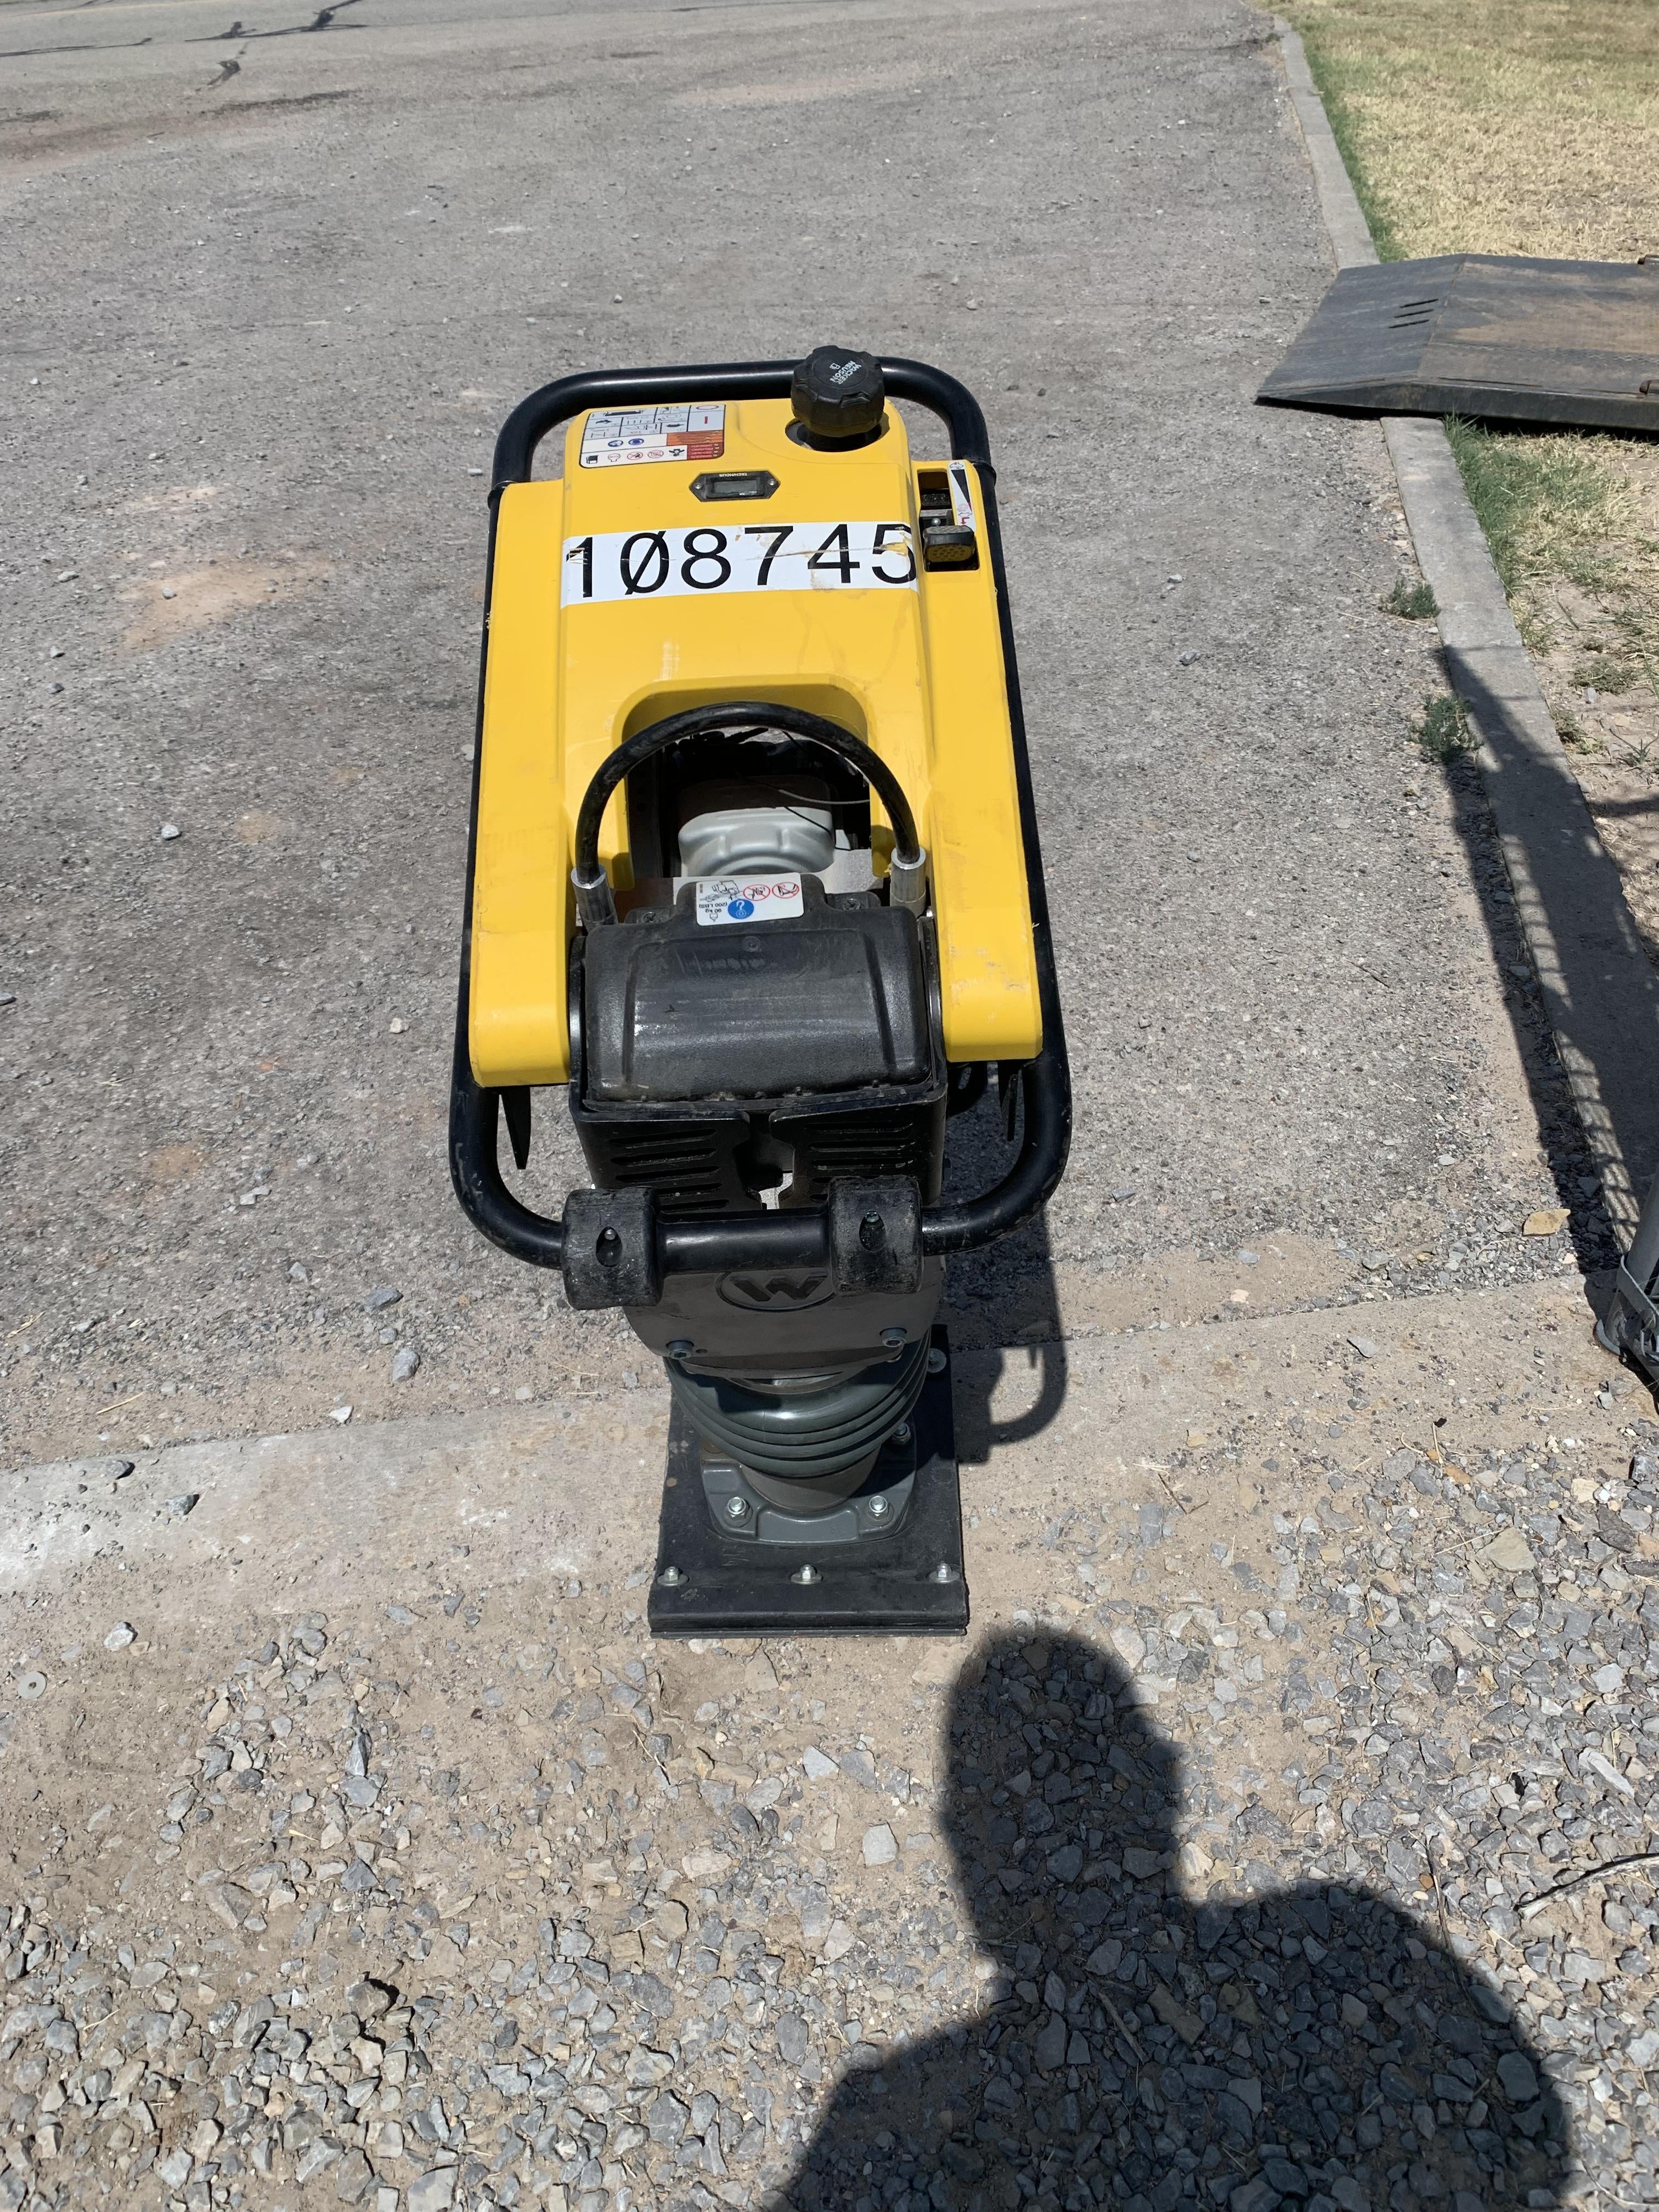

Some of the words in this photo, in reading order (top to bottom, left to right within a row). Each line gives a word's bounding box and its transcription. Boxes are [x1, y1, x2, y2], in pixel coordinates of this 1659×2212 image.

[830, 360, 856, 383] NEUSON
[838, 364, 862, 385] WACKER
[566, 523, 917, 598] 108745
